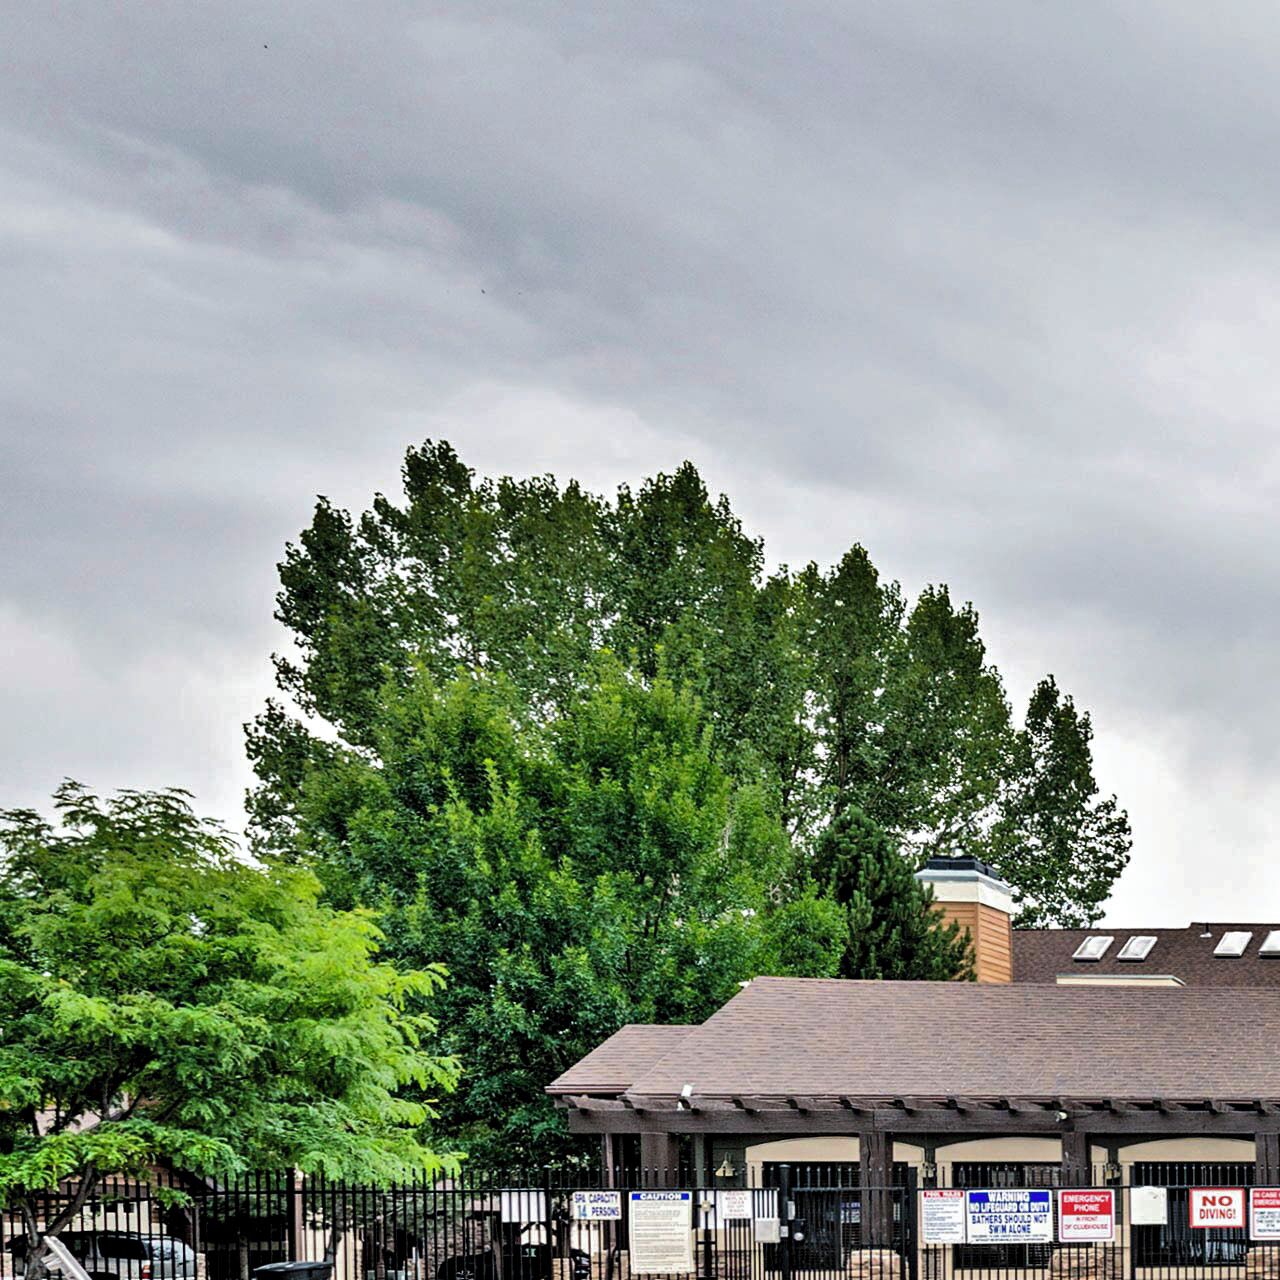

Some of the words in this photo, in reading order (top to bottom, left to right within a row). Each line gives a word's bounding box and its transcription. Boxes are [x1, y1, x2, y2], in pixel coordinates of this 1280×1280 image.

[575, 1194, 586, 1203] SPA
[589, 1193, 618, 1203] CAPACITY
[988, 1192, 1030, 1202] WARNING
[1064, 1195, 1110, 1203] EMERGENCY
[1202, 1196, 1233, 1206] NO
[591, 1206, 620, 1216] PERSONS
[970, 1202, 980, 1212] NO
[981, 1202, 1018, 1212] LIFEGUARD
[1019, 1202, 1029, 1212] ON
[1030, 1202, 1049, 1212] DUTY
[1074, 1204, 1100, 1212] PHONE
[1200, 1208, 1237, 1219] DIVING!
[972, 1214, 1003, 1224] BATHERS
[1004, 1214, 1032, 1223] SHOULD
[1034, 1214, 1048, 1223] NOT
[989, 1224, 1007, 1233] SWIM
[1009, 1224, 1032, 1233] ALONE
